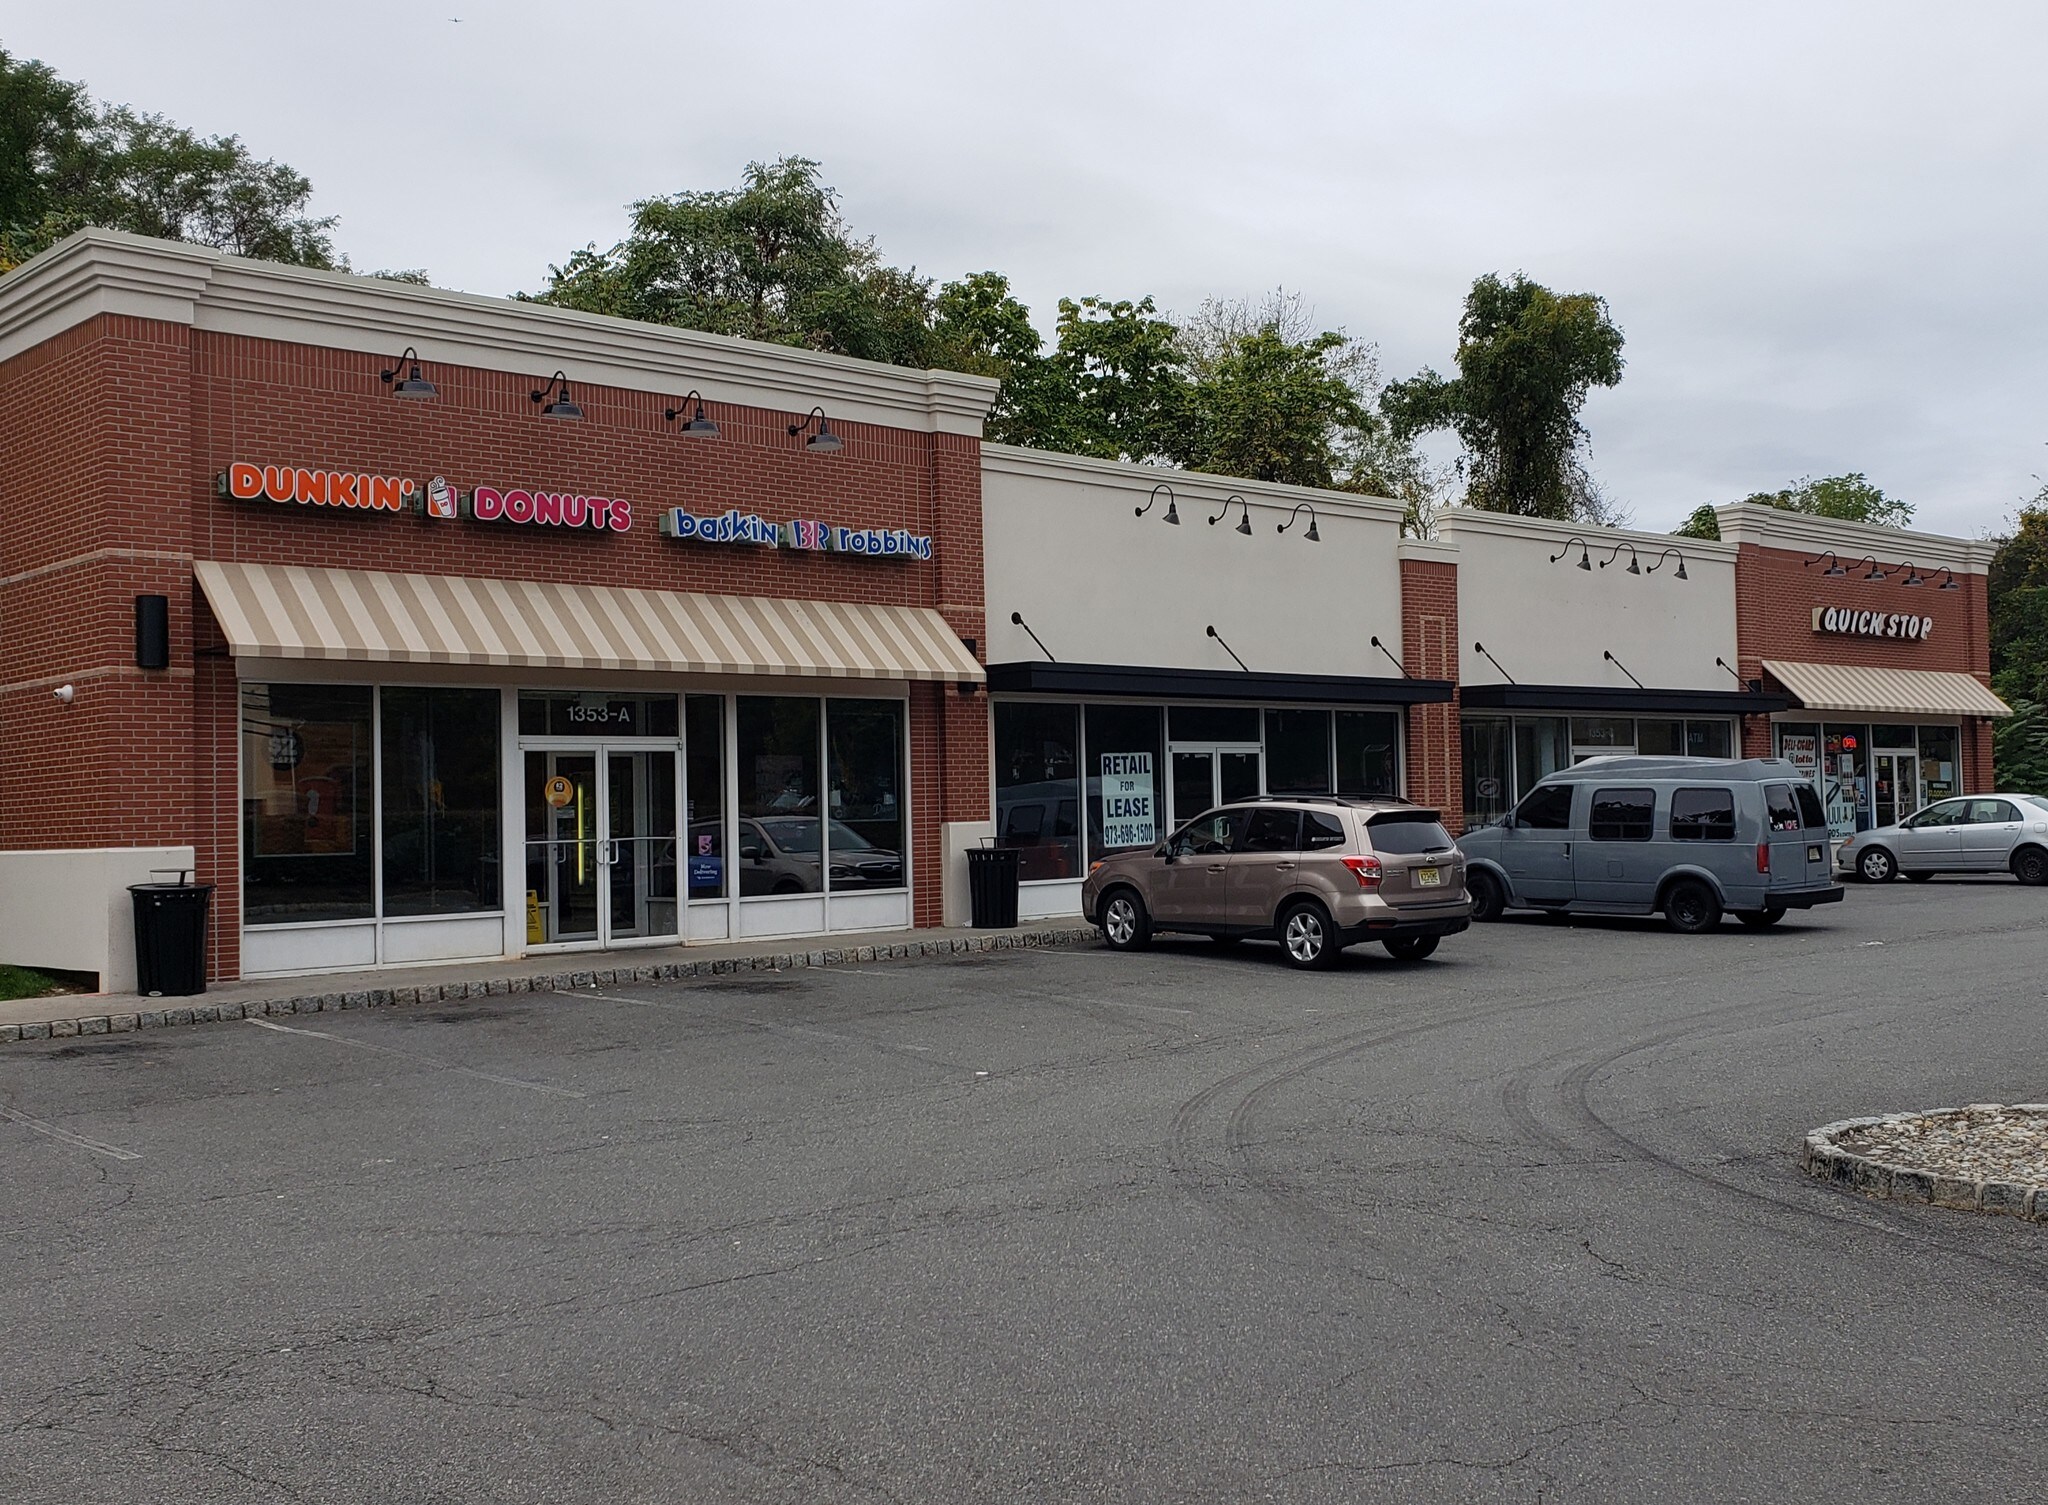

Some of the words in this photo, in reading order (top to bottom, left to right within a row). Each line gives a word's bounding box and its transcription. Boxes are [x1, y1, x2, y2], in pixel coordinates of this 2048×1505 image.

[229, 462, 414, 512] DUNKIN'
[474, 486, 632, 532] DONUTS
[672, 507, 778, 549] baskin
[792, 520, 829, 550] BR
[839, 527, 932, 560] robbins
[1823, 606, 1883, 636] QUICK
[1886, 613, 1933, 640] STOP
[566, 706, 630, 722] 1353-A
[1842, 738, 1857, 748] OPEN
[1103, 755, 1150, 775] RETAIL
[1795, 754, 1813, 764] lotto
[1120, 781, 1135, 791] FOR
[1106, 798, 1149, 818] LEASE
[1104, 823, 1153, 845] 973-696-1500
